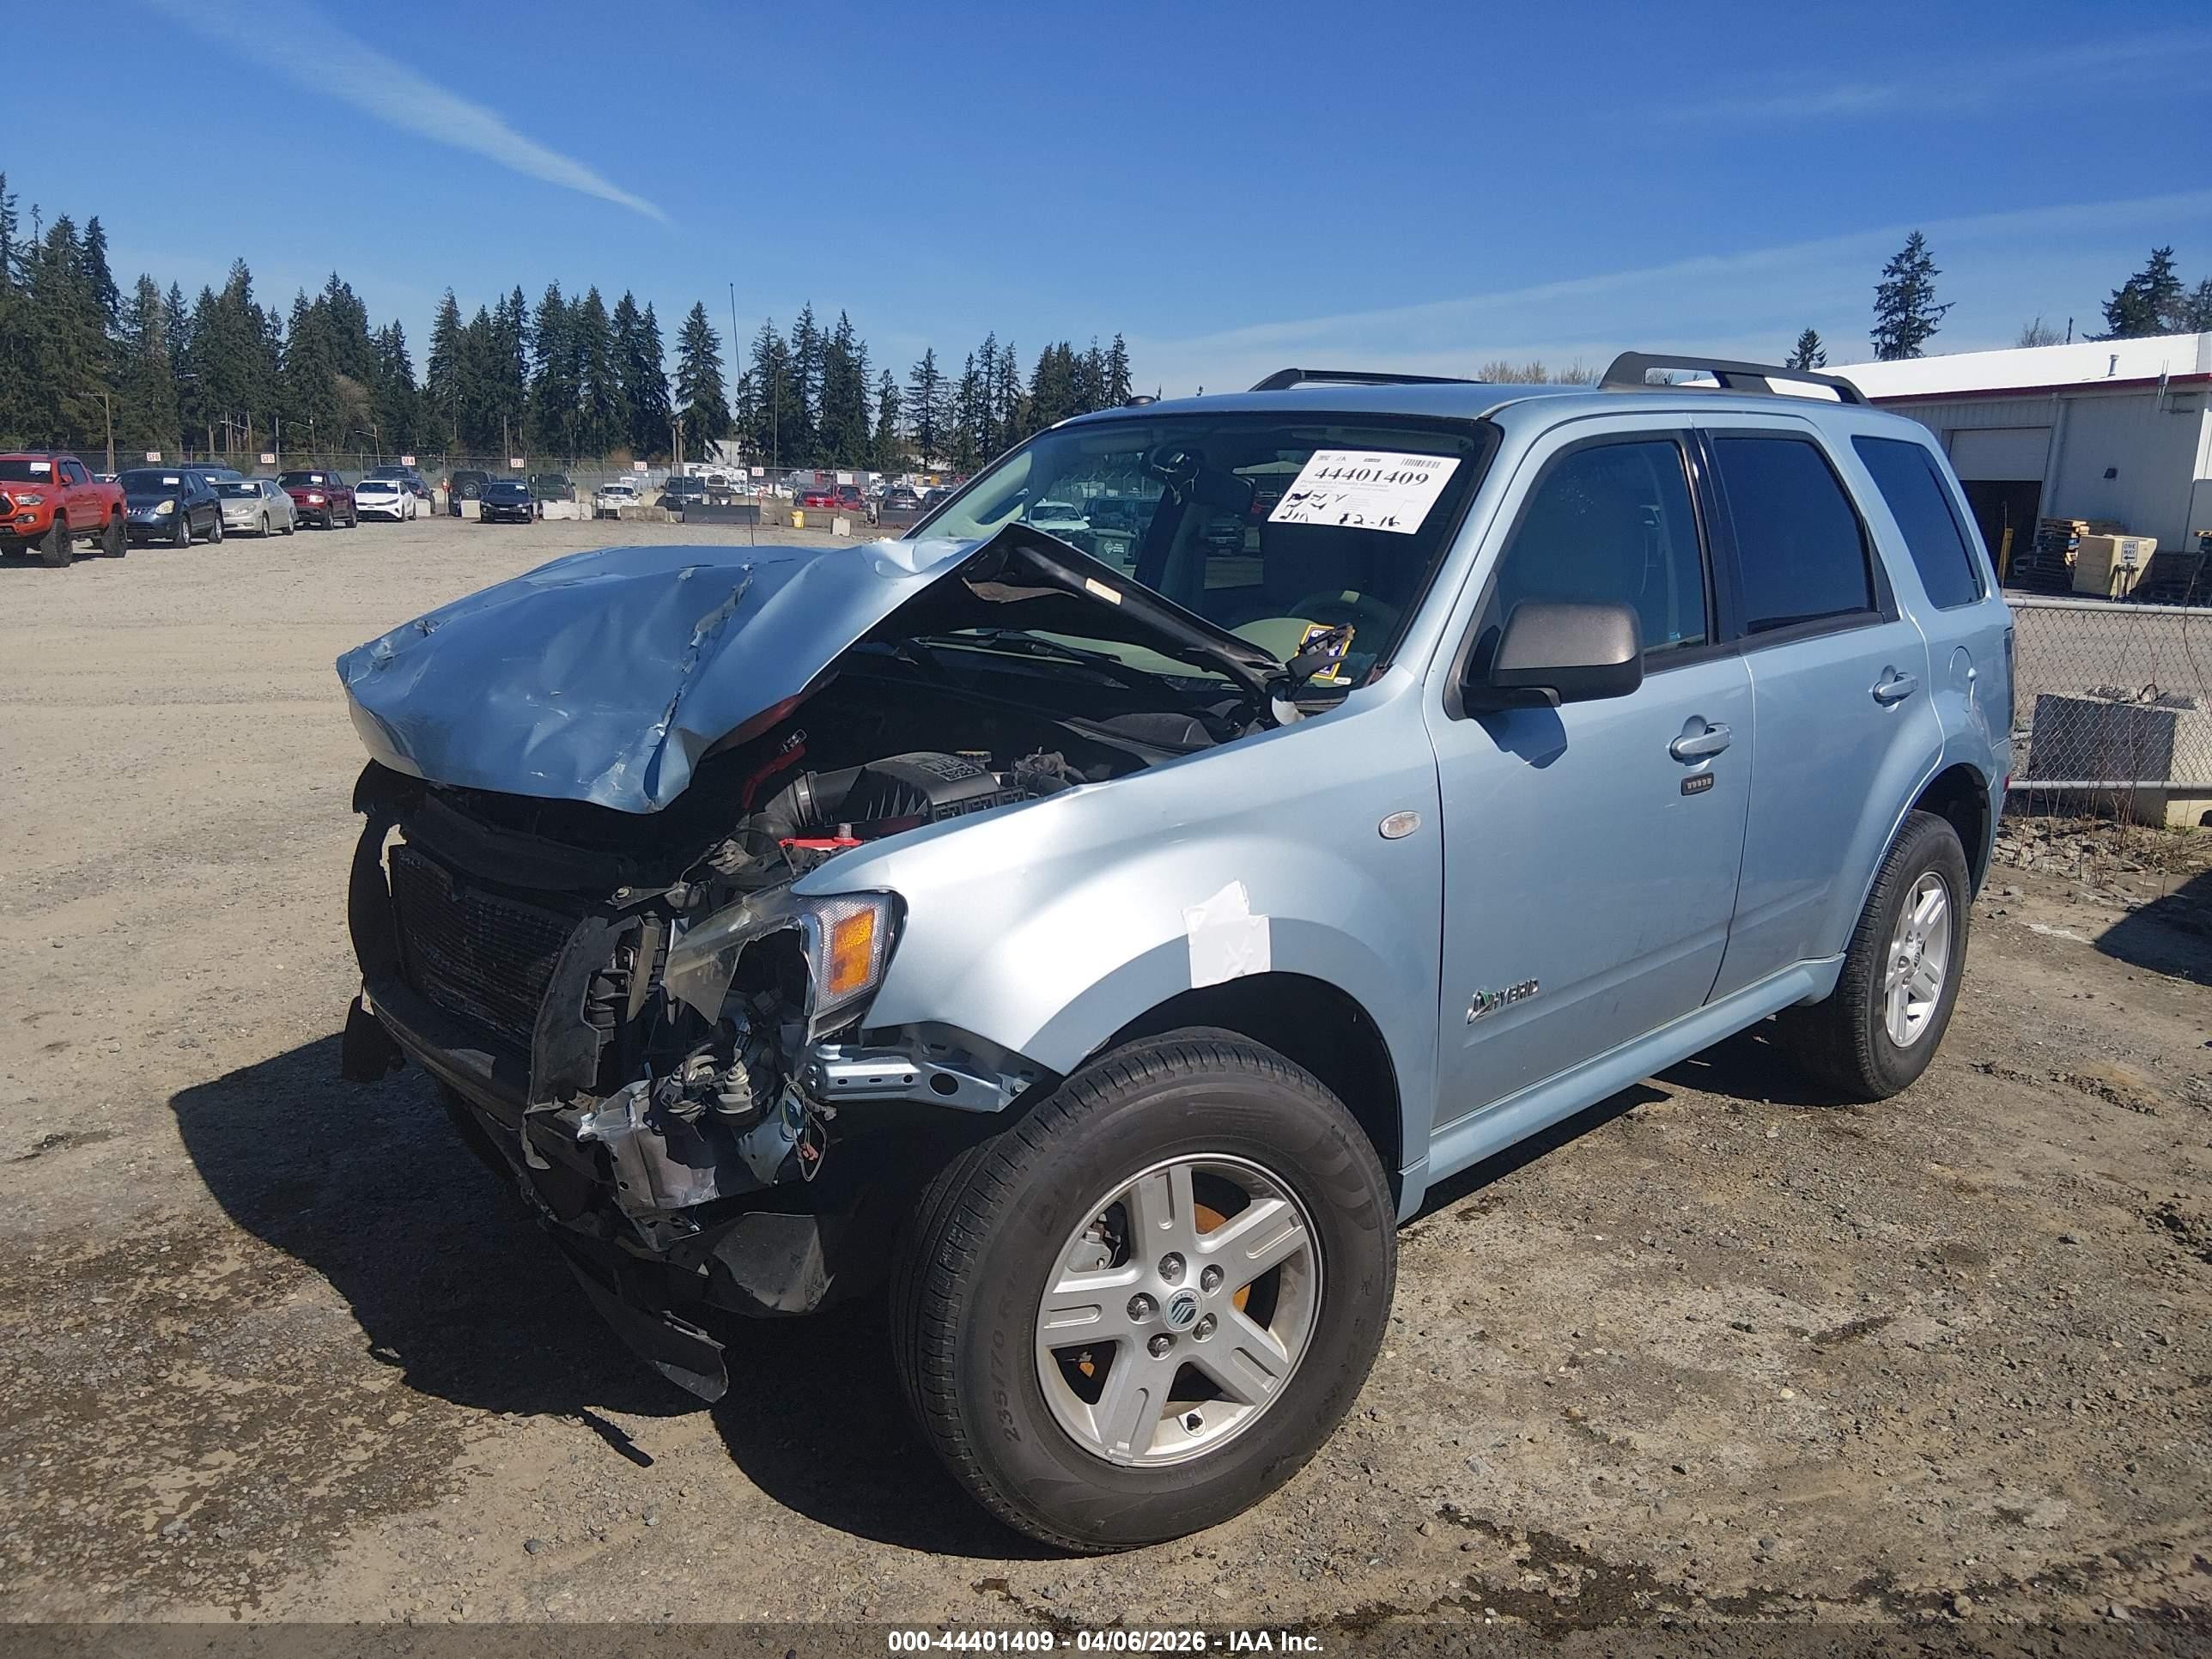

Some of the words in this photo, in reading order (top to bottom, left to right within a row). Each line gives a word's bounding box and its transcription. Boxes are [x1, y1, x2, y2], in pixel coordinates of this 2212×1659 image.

[147, 453, 161, 461] SF6
[262, 454, 275, 463] SF5
[402, 457, 415, 465] SF4
[635, 462, 647, 471] SF2
[1314, 466, 1430, 487] 44401409
